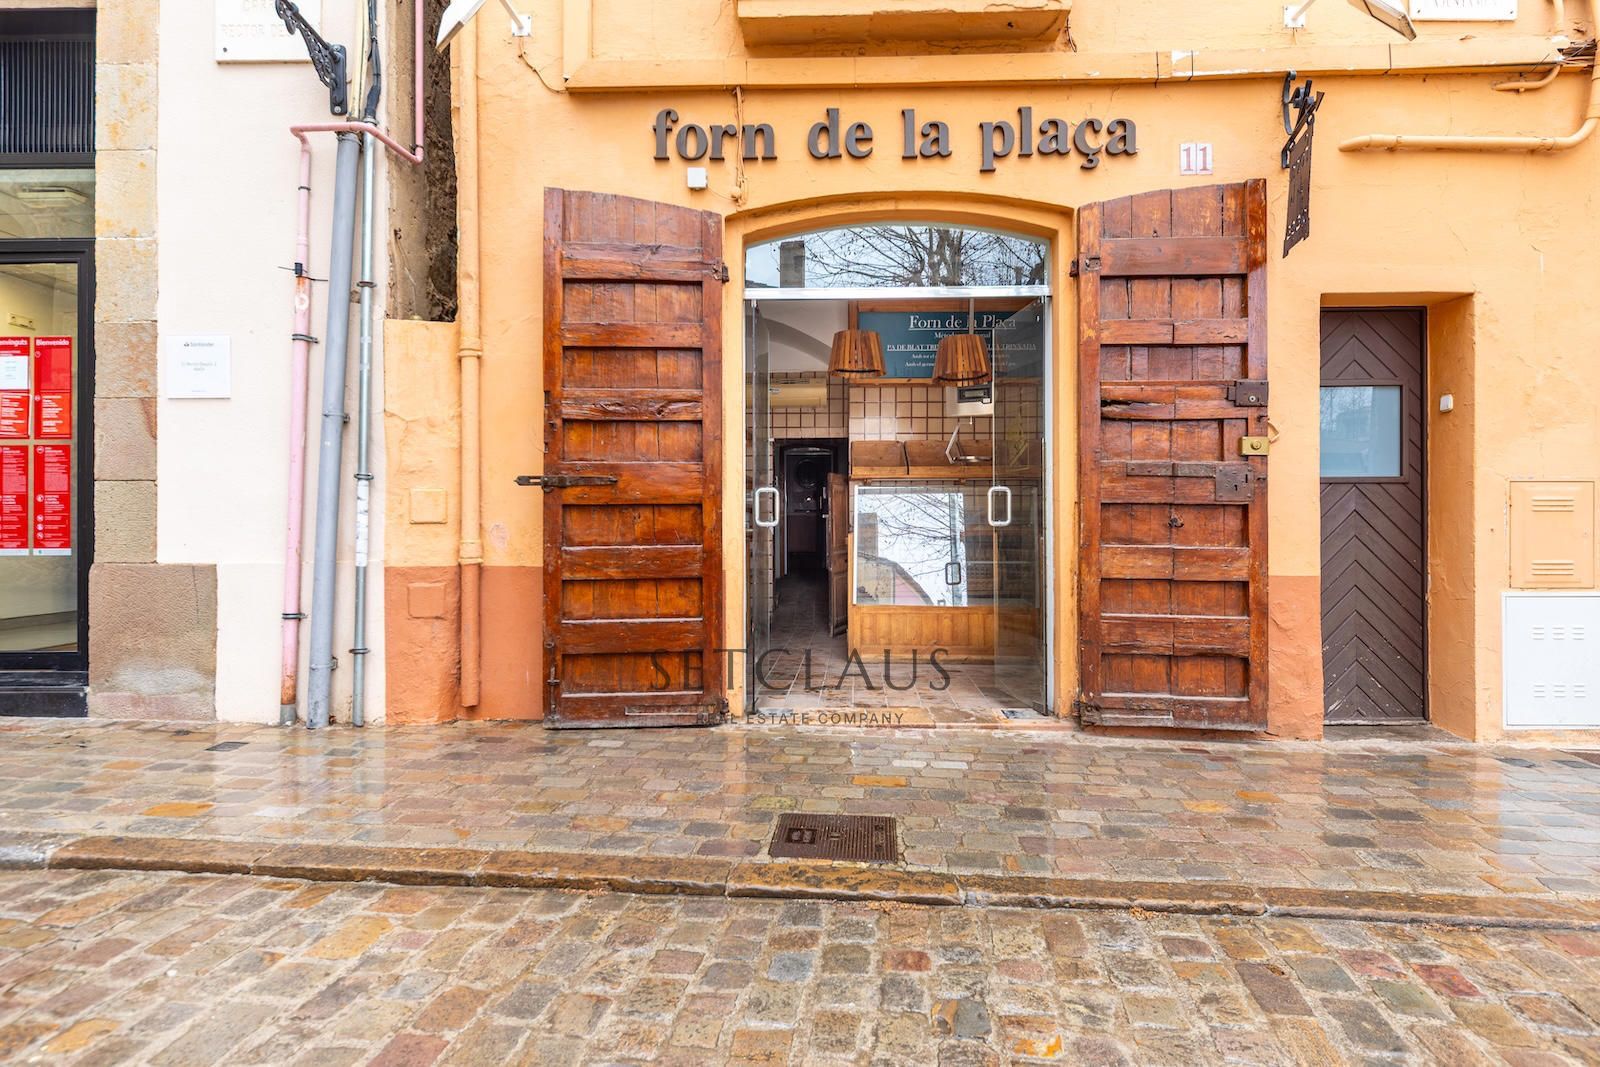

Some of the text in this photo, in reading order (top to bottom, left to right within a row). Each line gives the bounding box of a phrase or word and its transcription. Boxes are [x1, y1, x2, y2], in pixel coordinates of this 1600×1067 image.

[653, 106, 1139, 172] forn de la plaça
[1182, 145, 1212, 172] 11
[910, 315, 941, 329] Forn
[945, 315, 962, 329] de
[982, 315, 1016, 330] Plaça
